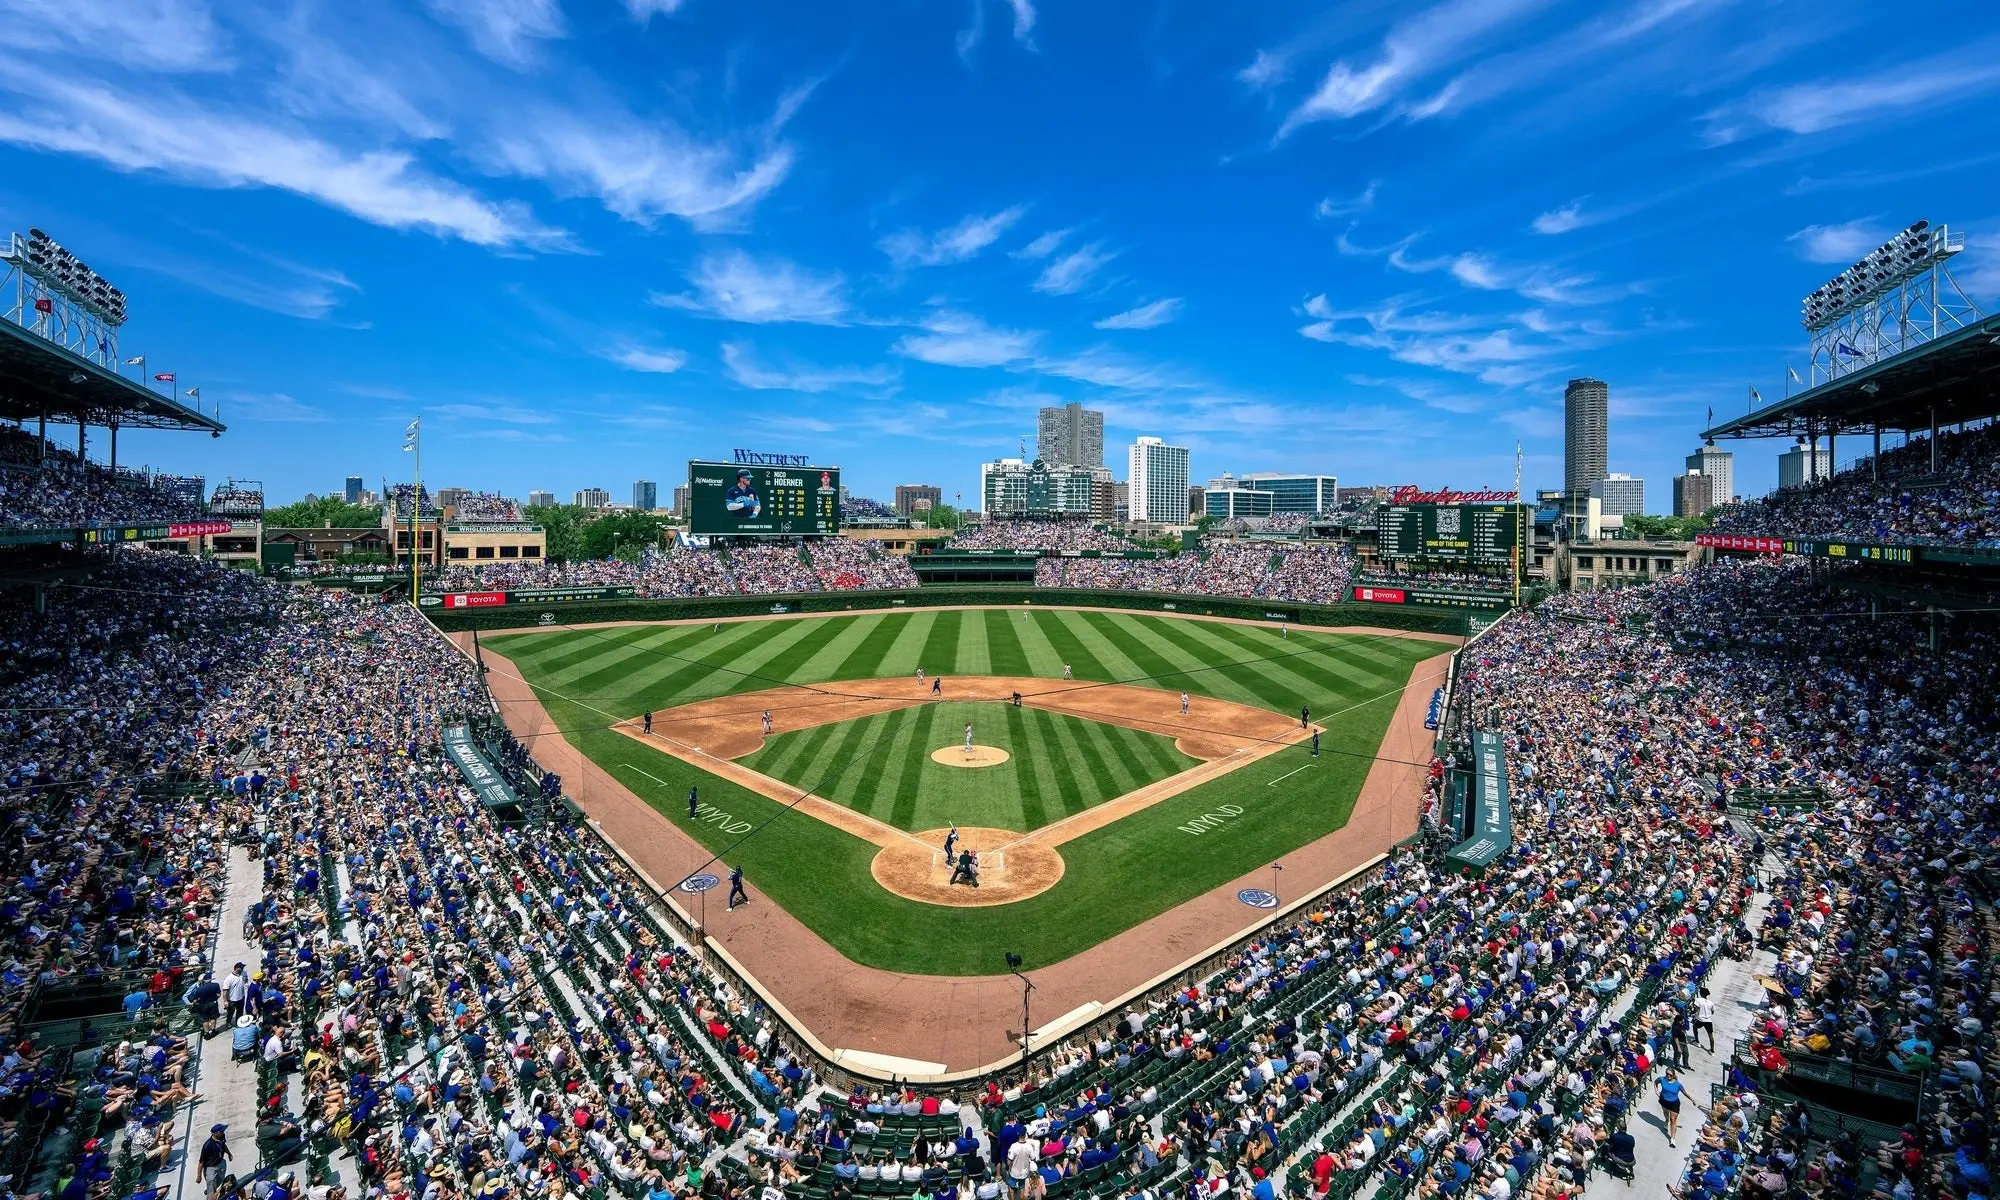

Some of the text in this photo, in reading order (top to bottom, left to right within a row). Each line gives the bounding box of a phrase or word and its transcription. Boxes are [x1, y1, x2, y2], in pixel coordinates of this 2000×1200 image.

[733, 449, 809, 467] WINTRUST
[774, 478, 803, 487] HOERNER
[1387, 486, 1518, 504] Budweiser
[685, 803, 752, 834] MYND
[1177, 804, 1244, 836] MYND
